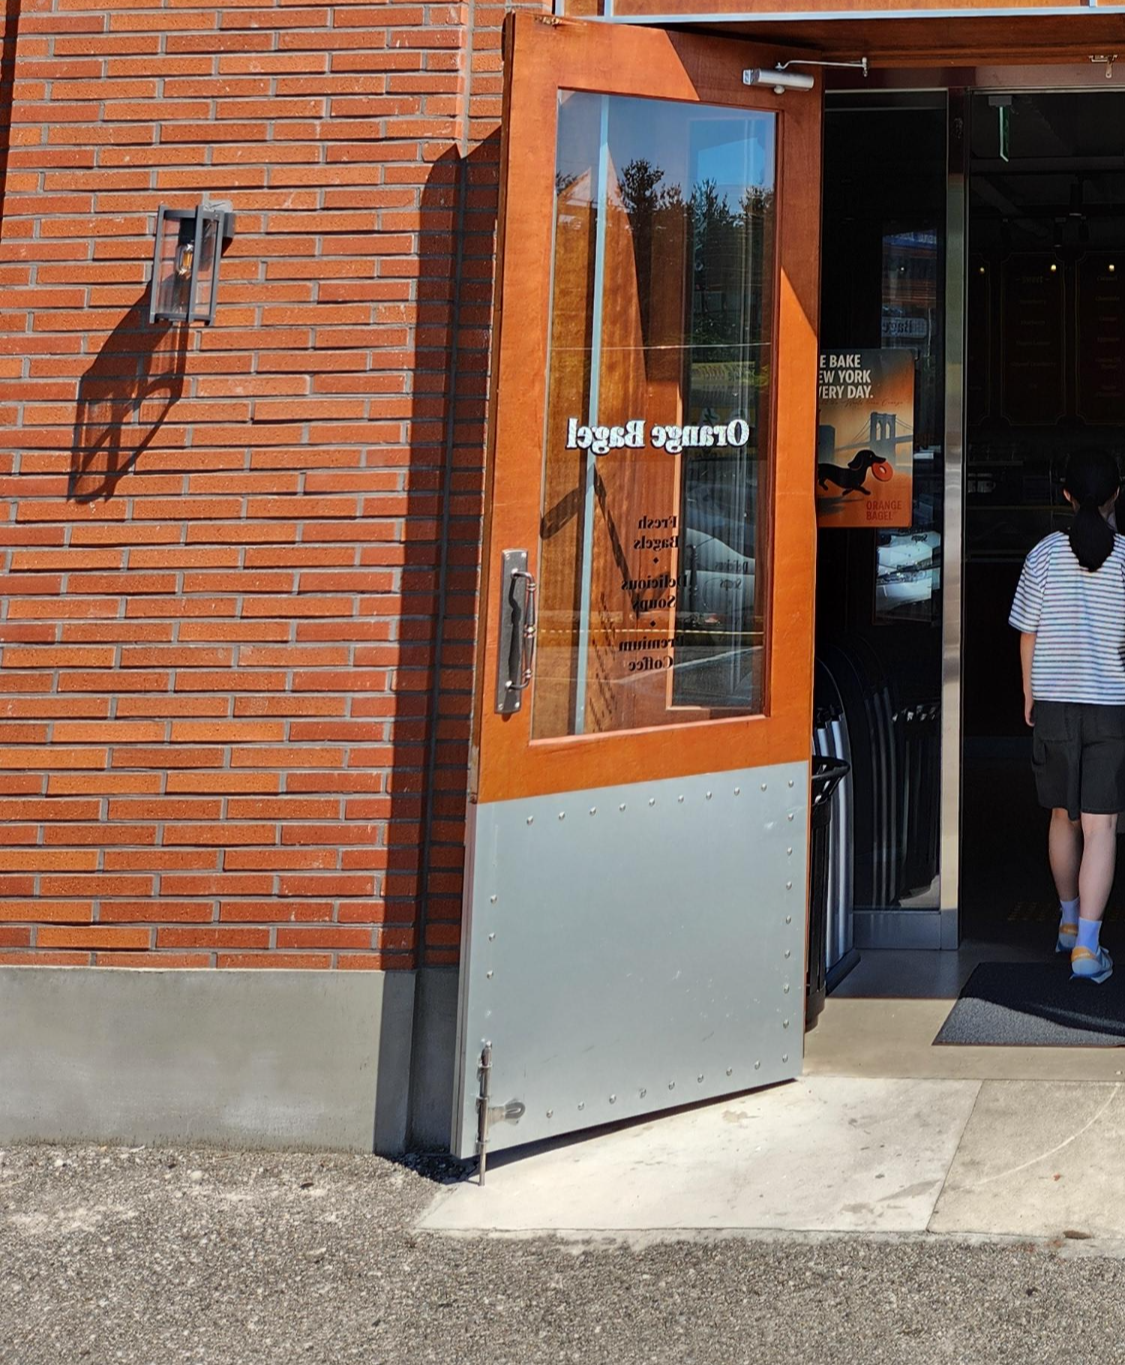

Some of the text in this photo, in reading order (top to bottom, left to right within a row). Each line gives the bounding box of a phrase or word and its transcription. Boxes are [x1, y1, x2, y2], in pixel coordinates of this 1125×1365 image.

[819, 355, 860, 368] E BAKE
[819, 370, 871, 383] EW YORK
[819, 385, 873, 399] ERY DAY.
[866, 500, 901, 510] ORANGE
[866, 511, 893, 521] BAGEL
